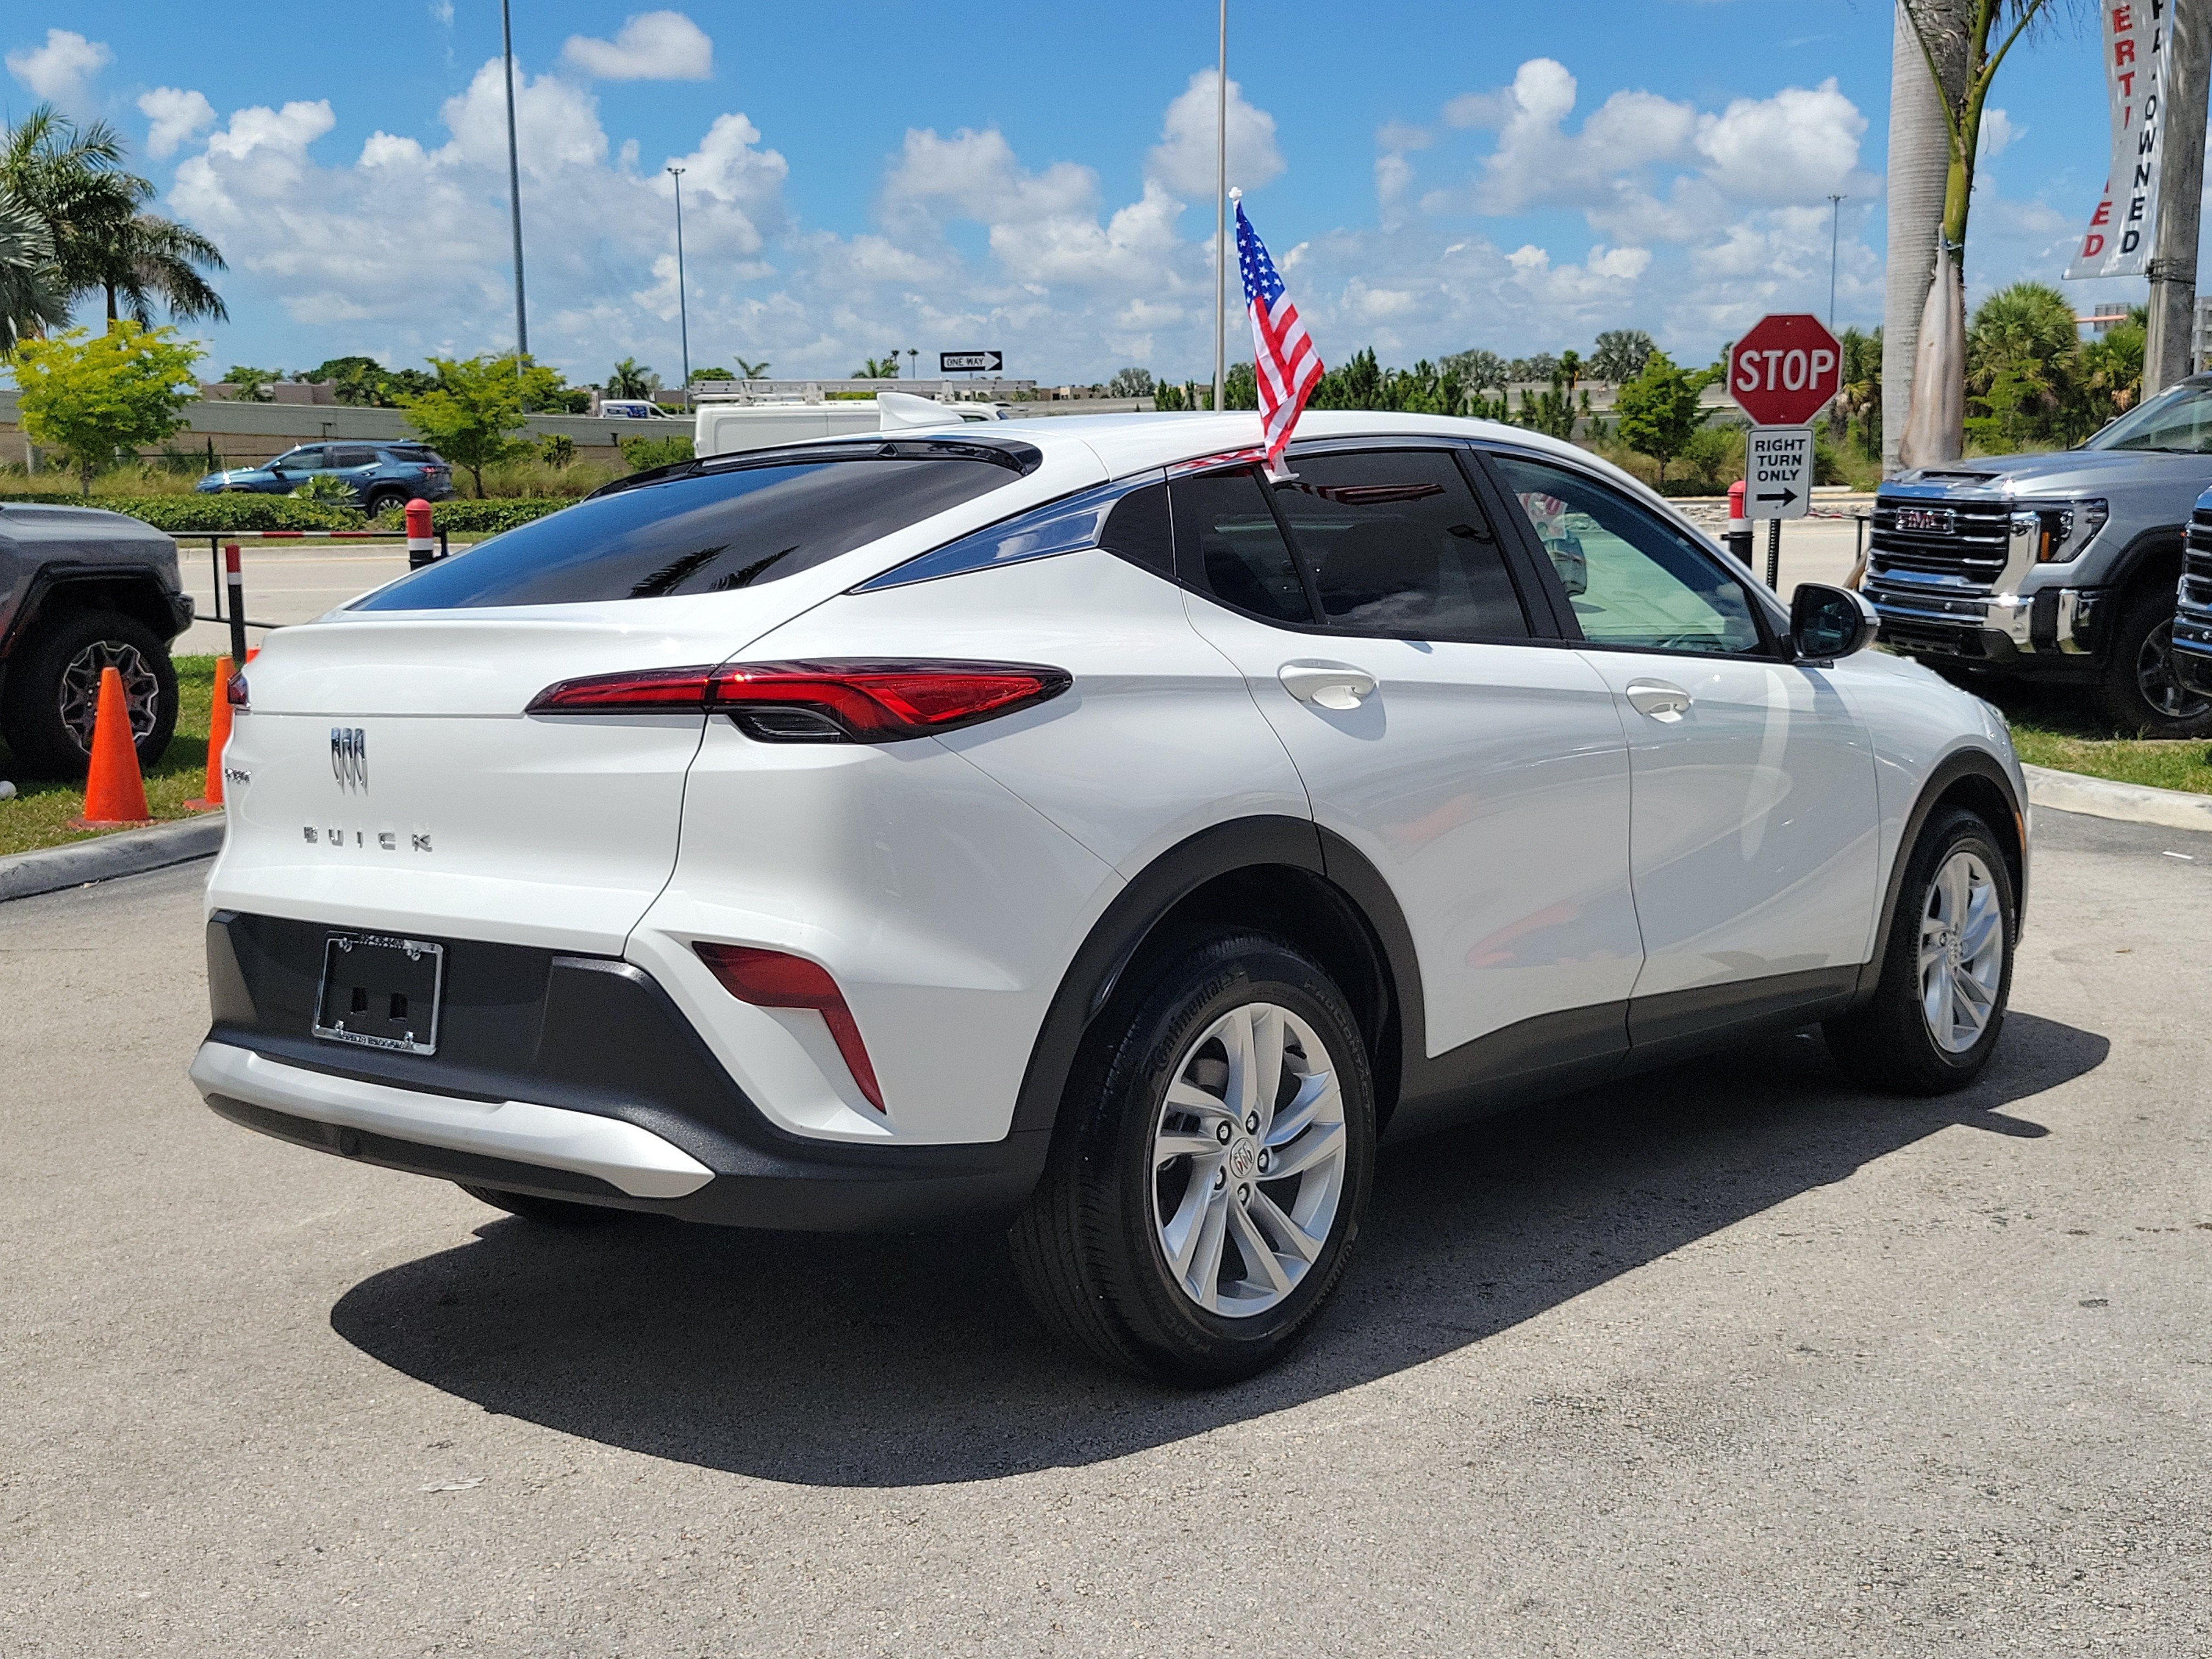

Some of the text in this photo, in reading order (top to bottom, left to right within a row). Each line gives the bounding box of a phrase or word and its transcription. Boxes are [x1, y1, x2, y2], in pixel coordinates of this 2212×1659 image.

[946, 357, 985, 366] ONE WAY
[1736, 348, 1835, 391] STOP
[1756, 439, 1806, 452] RIGHT
[1757, 454, 1802, 466] TURN
[1757, 469, 1800, 482] ONLY
[1897, 510, 1948, 531] GMC
[303, 826, 433, 853] BUICK
